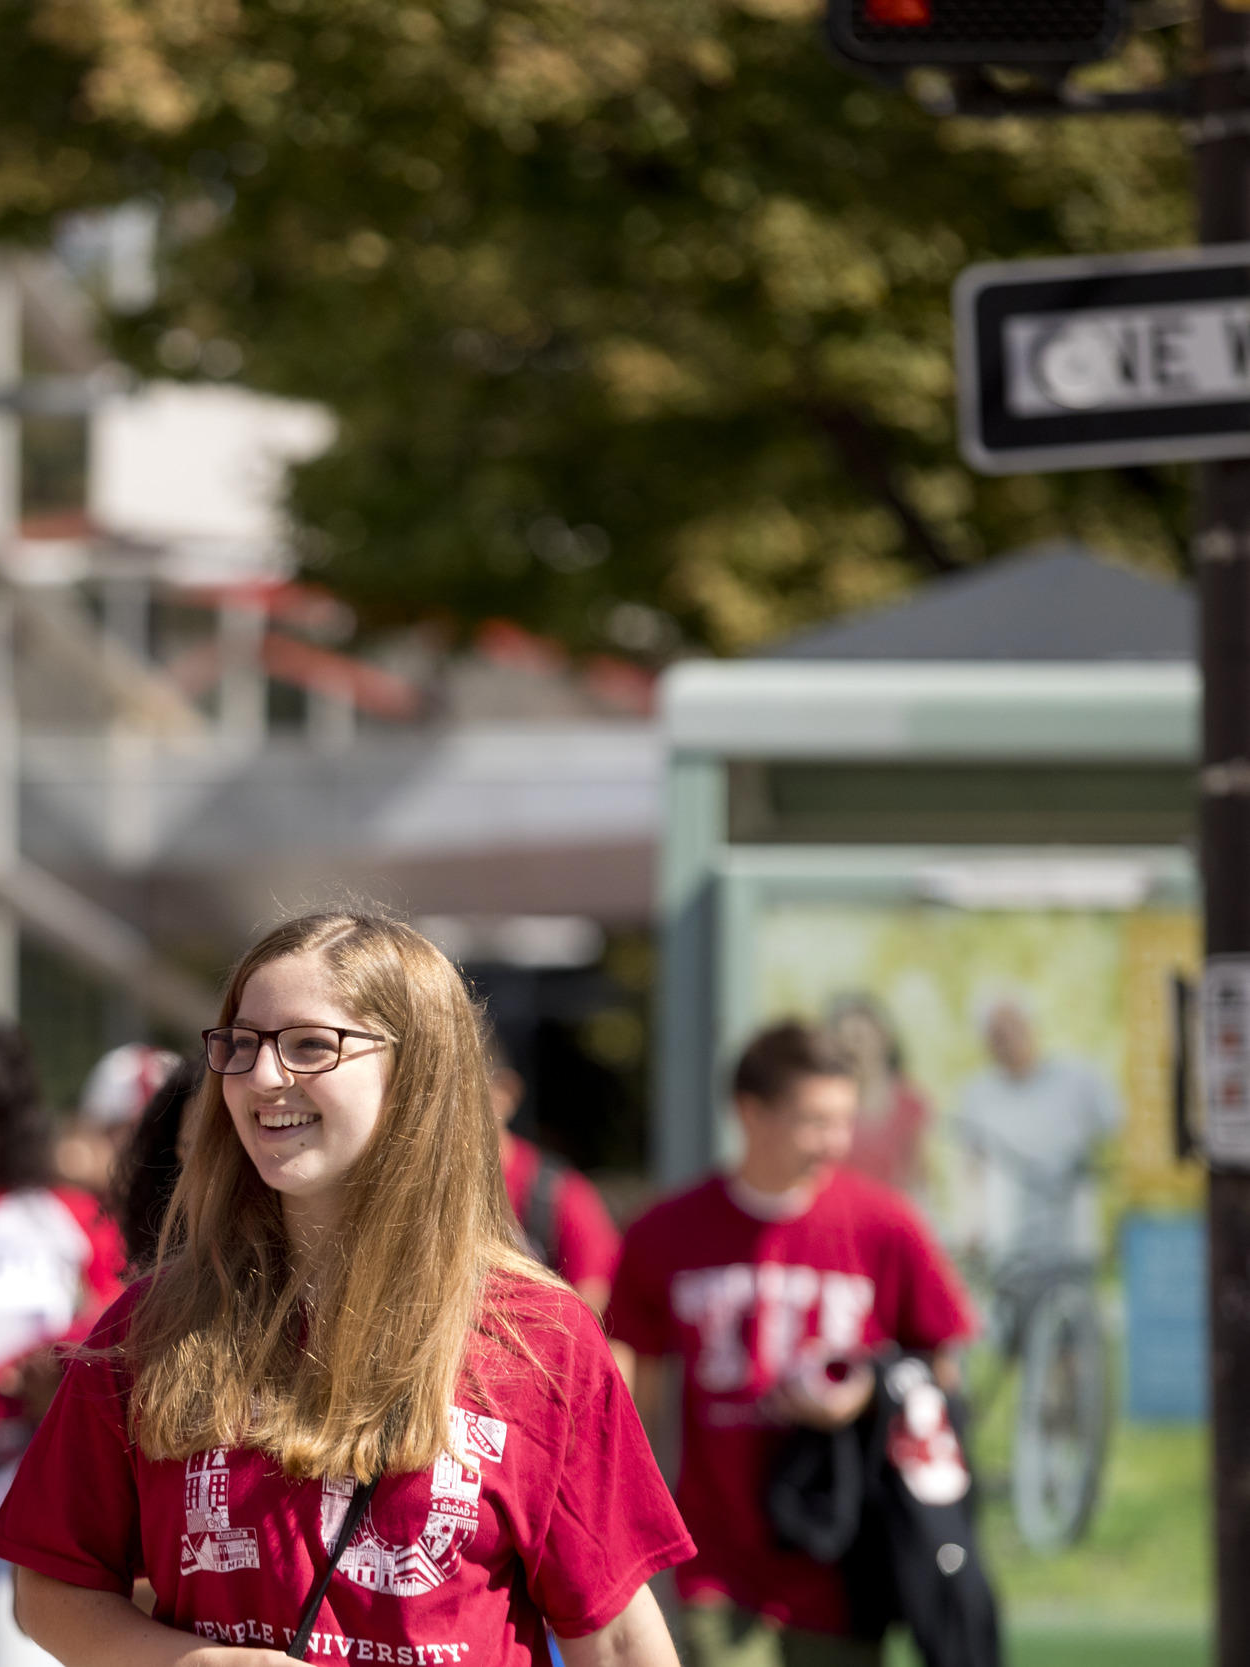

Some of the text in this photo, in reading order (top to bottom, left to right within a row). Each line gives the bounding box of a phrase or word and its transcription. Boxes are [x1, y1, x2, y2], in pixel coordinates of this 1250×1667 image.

[470, 1425, 492, 1453] OWLS
[439, 1502, 471, 1518] BROAD
[215, 1559, 257, 1571] TEMPLE
[194, 1619, 275, 1645] TEMPLE
